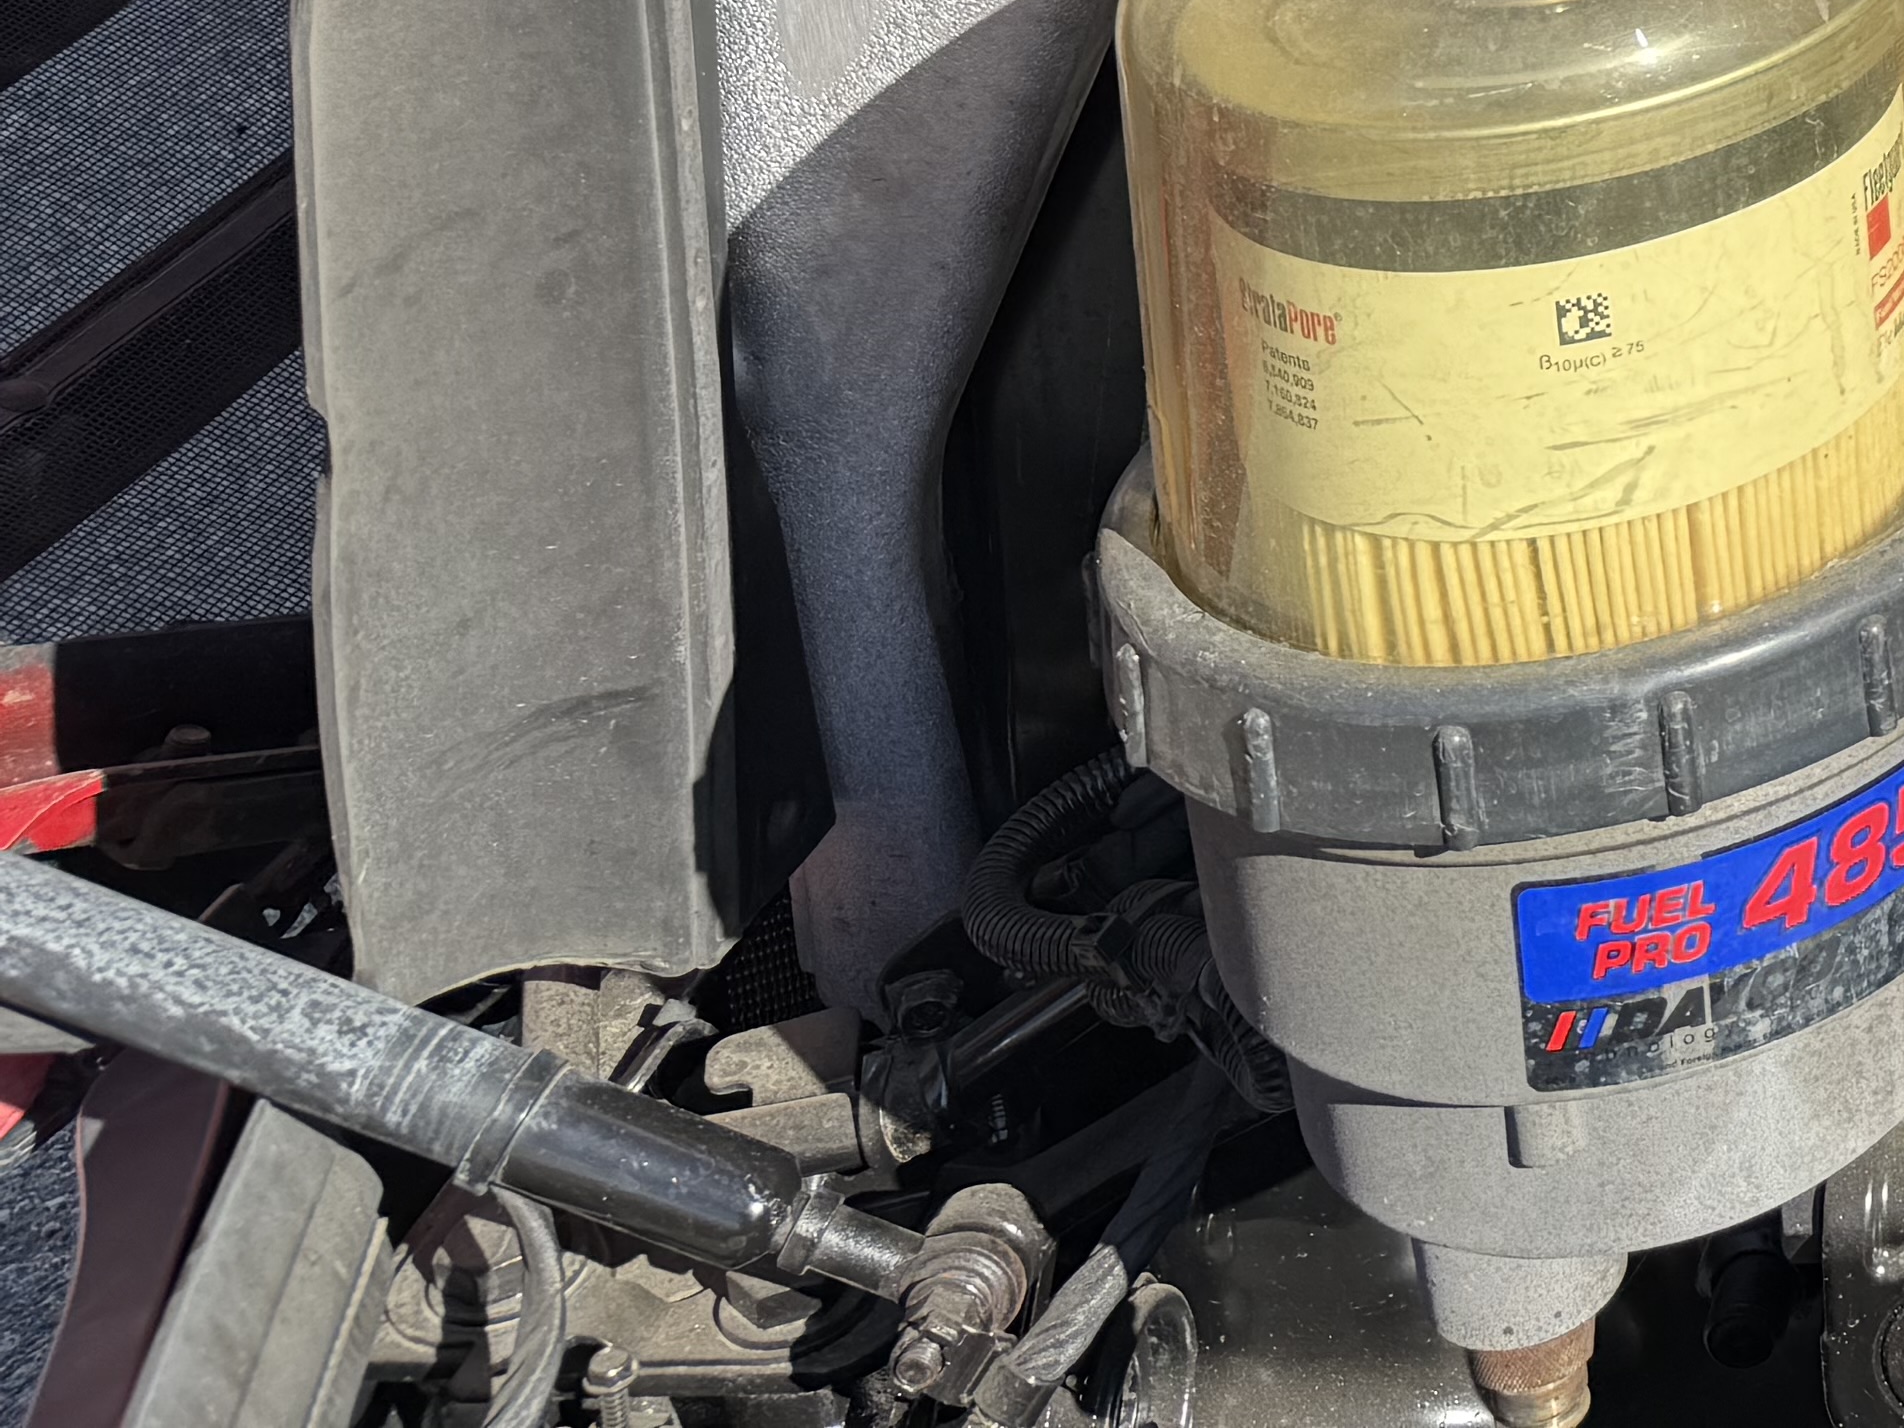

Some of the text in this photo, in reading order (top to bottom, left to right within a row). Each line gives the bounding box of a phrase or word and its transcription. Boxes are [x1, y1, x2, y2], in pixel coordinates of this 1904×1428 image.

[1261, 338, 1311, 372] Patents
[1625, 340, 1646, 355] 75
[1575, 878, 1717, 942] FUEL
[1592, 921, 1712, 981] PRO
